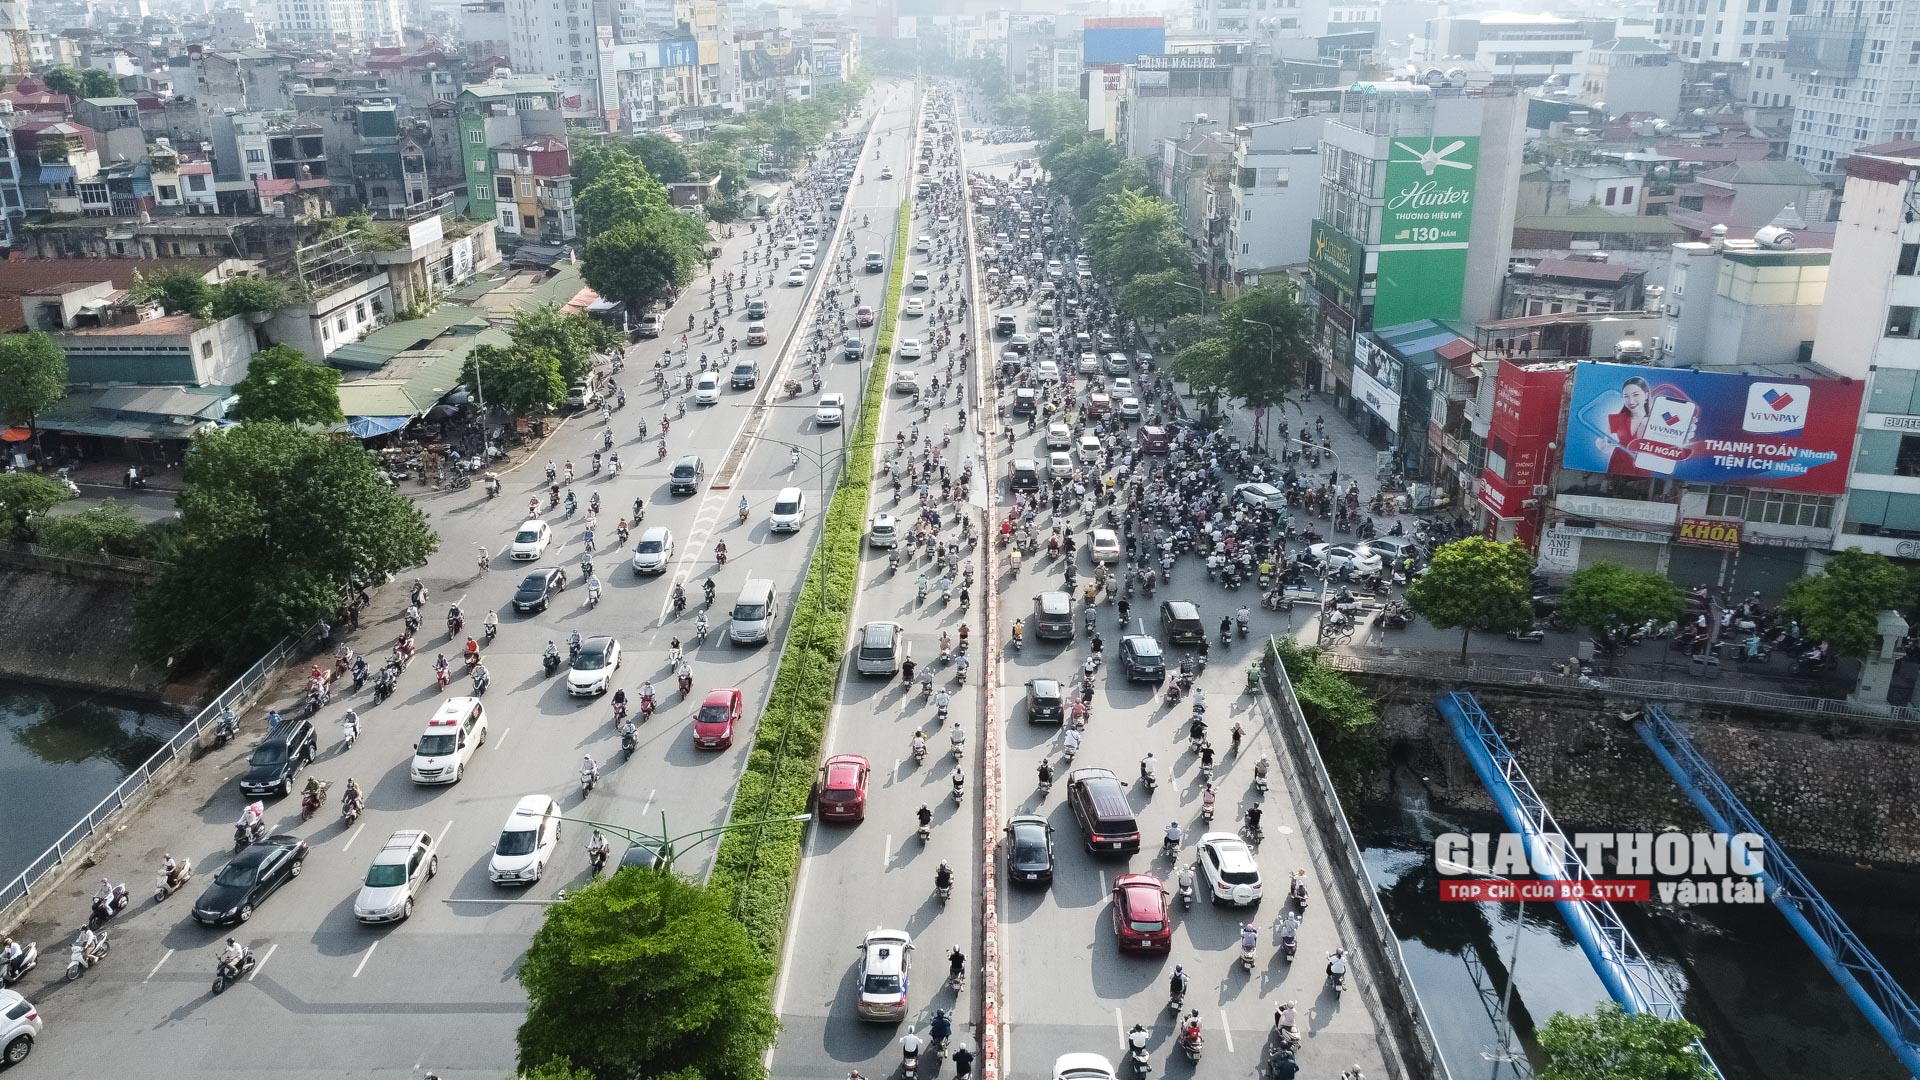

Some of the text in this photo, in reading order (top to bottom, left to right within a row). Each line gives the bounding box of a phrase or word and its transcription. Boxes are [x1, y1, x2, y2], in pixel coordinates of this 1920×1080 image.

[1388, 181, 1469, 210] Hunter
[1432, 211, 1450, 220] HIỆU
[1451, 211, 1463, 219] MỸ
[1412, 227, 1439, 241] 130
[1764, 412, 1799, 423] VNPAY
[1639, 442, 1682, 458] TẢI NGAY
[1704, 439, 1838, 460] THANH TOÁN Nhanh
[1713, 455, 1744, 470] TIỆN
[1746, 456, 1773, 470] ÍCH
